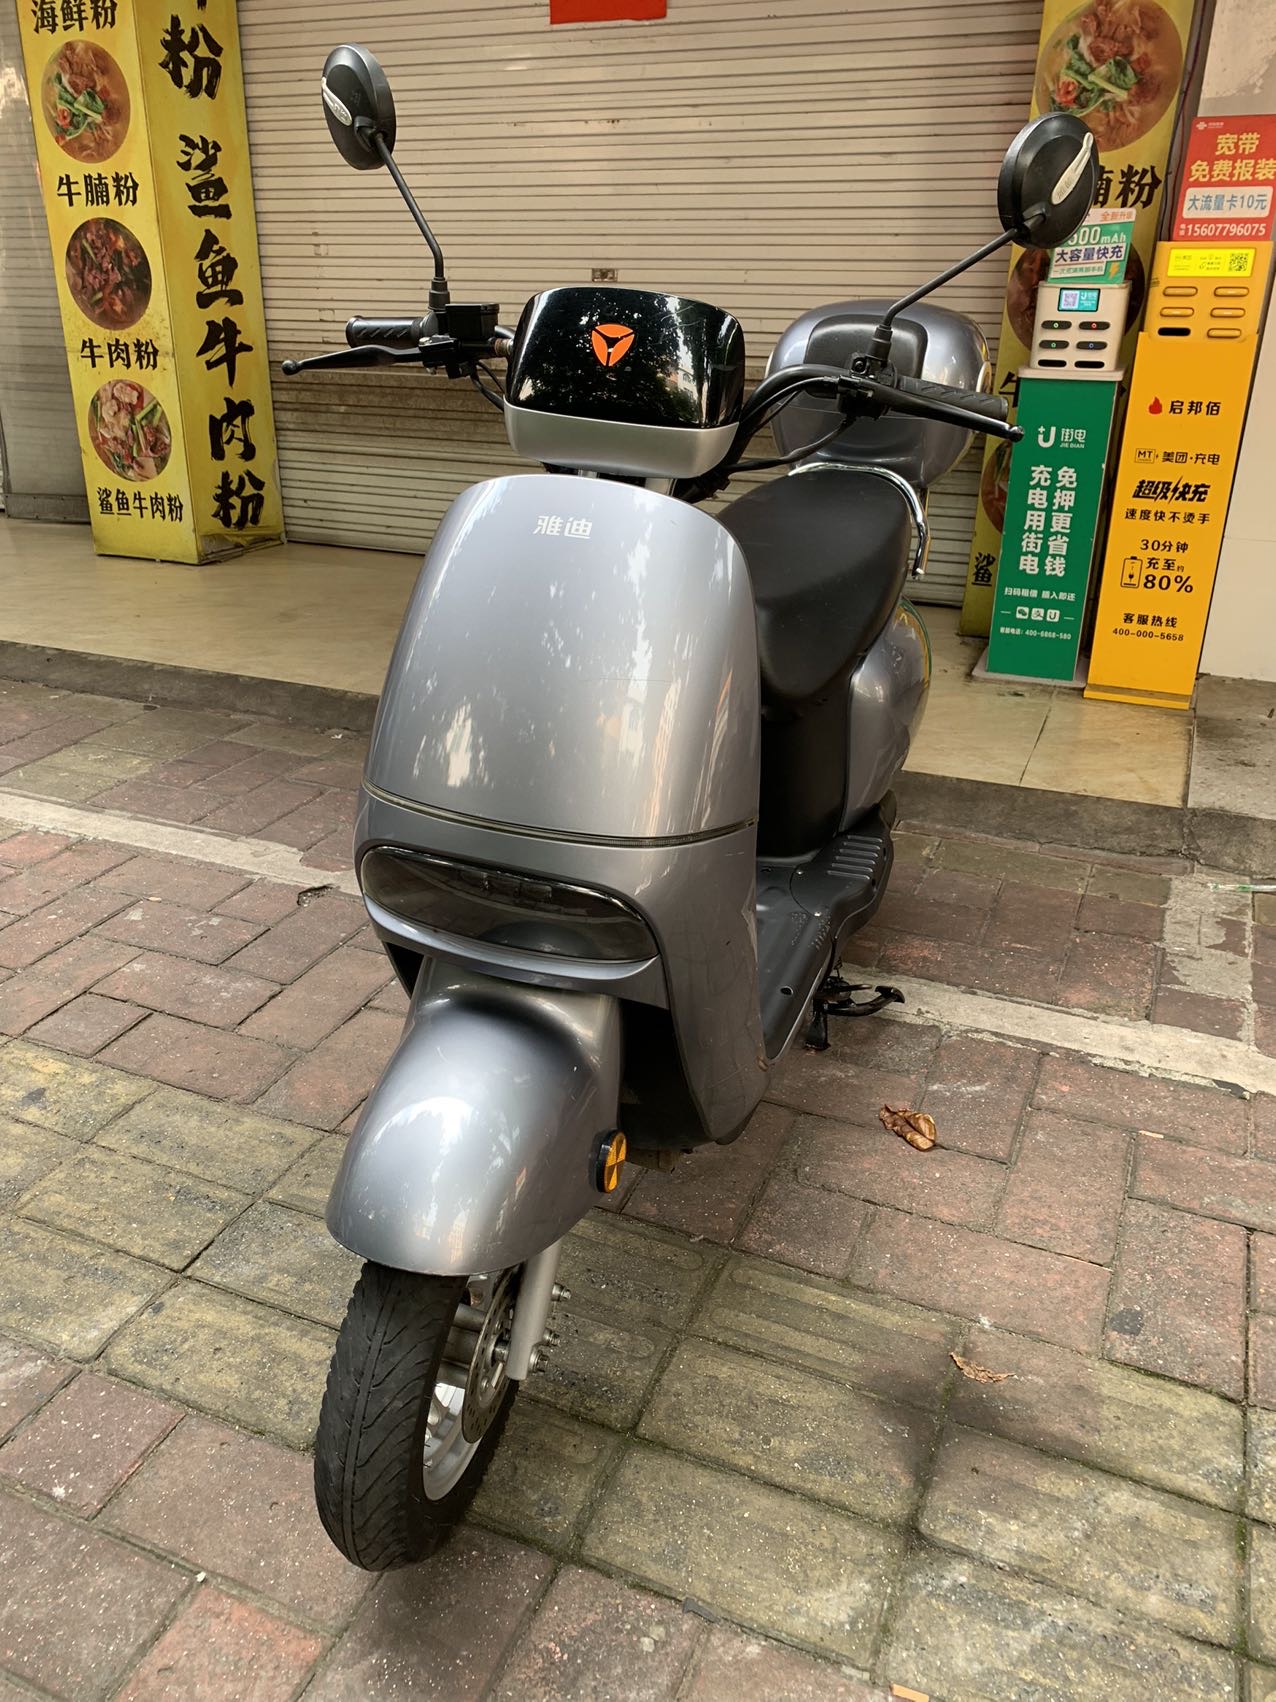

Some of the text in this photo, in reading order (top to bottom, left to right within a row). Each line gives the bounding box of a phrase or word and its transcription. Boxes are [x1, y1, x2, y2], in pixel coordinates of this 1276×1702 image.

[31, 0, 118, 34] 海鲜粉
[158, 0, 224, 100] 粉
[1215, 132, 1260, 155] 宽带
[1188, 158, 1276, 182] 免费报装
[57, 171, 140, 208] 牛腩粉
[1187, 194, 1268, 212] 大流量卡10元
[1187, 223, 1266, 237] 15607796075
[1055, 245, 1124, 263] 大容量快充
[176, 134, 266, 531] 鲨鱼牛肉粉
[80, 337, 160, 371] 牛肉粉
[1168, 400, 1222, 416] 启邦佰
[1060, 428, 1087, 442] 街电
[1137, 450, 1153, 459] MT
[1132, 477, 1211, 503] 超级快充
[96, 486, 184, 523] 鲨鱼牛肉粉
[1125, 508, 1210, 524] 速度快不烫手
[533, 515, 593, 540] 雅迪
[1019, 464, 1053, 576] 充电用街电
[1044, 465, 1078, 577] 免押更省钱
[1140, 538, 1189, 554] 30分钟
[1143, 573, 1194, 593] 80%
[1123, 612, 1178, 628] 客服热线
[1112, 627, 1184, 642] 400-000-5658
